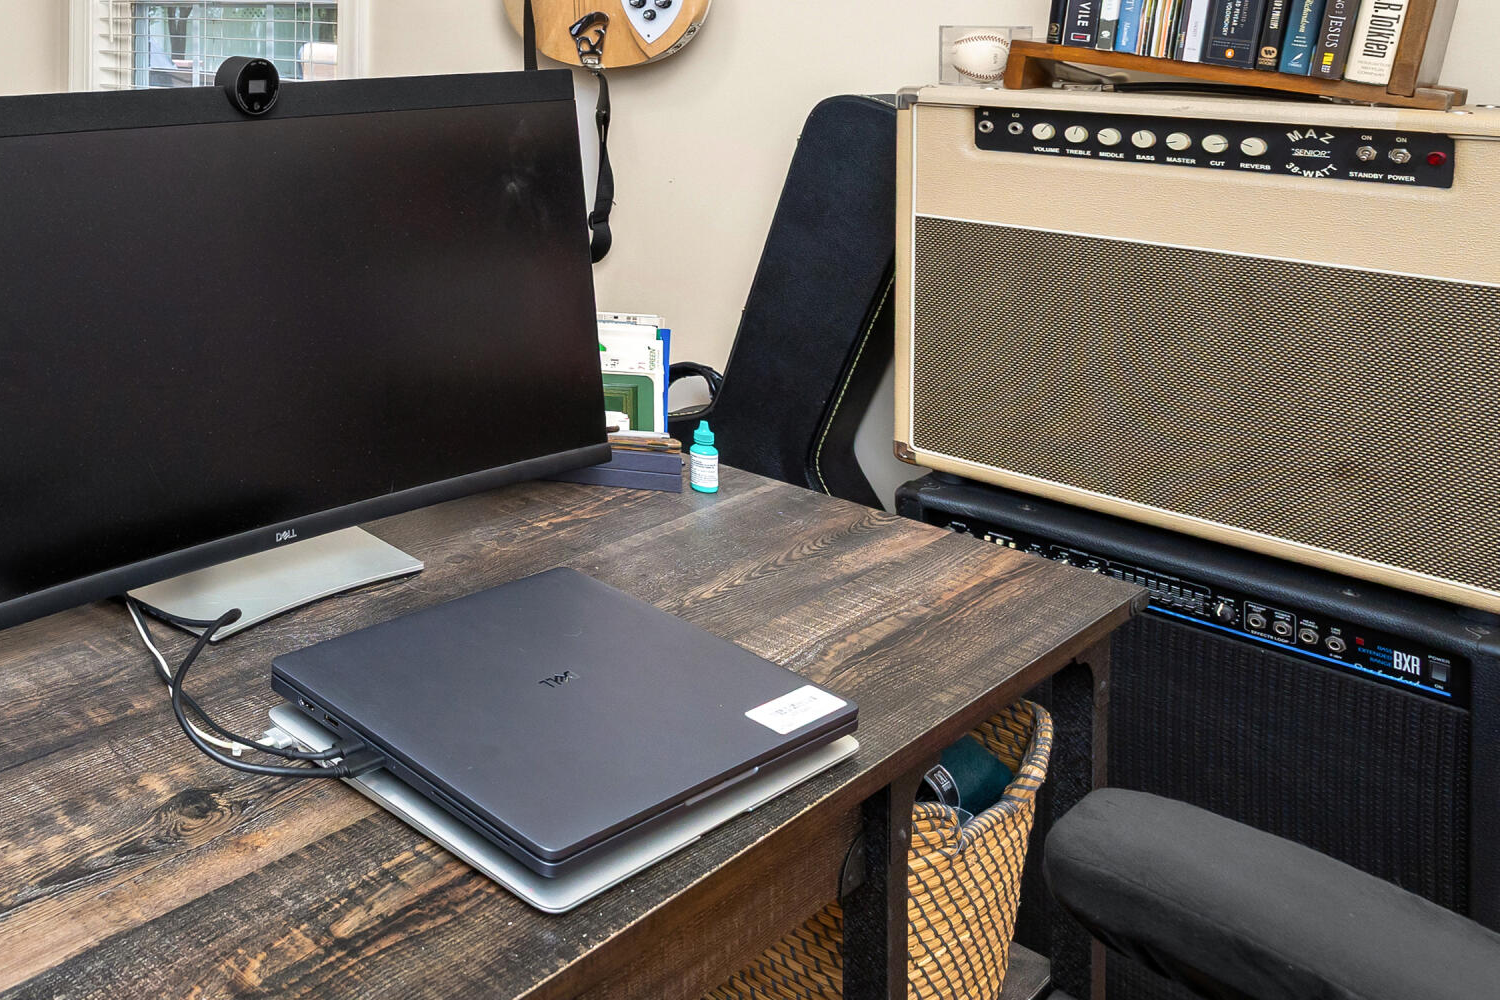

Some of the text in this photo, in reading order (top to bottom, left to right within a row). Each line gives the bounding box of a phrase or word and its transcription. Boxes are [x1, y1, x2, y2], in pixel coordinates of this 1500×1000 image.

[1077, 2, 1092, 27] VILE
[1325, 15, 1346, 48] JESUS
[1362, 14, 1401, 59] Tolkien
[1286, 128, 1335, 144] MAZ
[1066, 148, 1091, 156] TREBLE
[1099, 151, 1124, 159] MIDDLE
[1166, 156, 1196, 164] MASTER
[1240, 162, 1271, 170] REVERB
[1285, 162, 1338, 178] 38-WATT
[1349, 171, 1384, 179] STANDBY
[276, 529, 297, 542] DELL
[1251, 629, 1290, 644] EFFECTS LOOP
[1357, 647, 1393, 660] EXTENDED
[1377, 645, 1393, 654] BASS
[1369, 656, 1393, 668] RANGE
[1393, 650, 1421, 676] BXR
[1427, 654, 1451, 664] POWER
